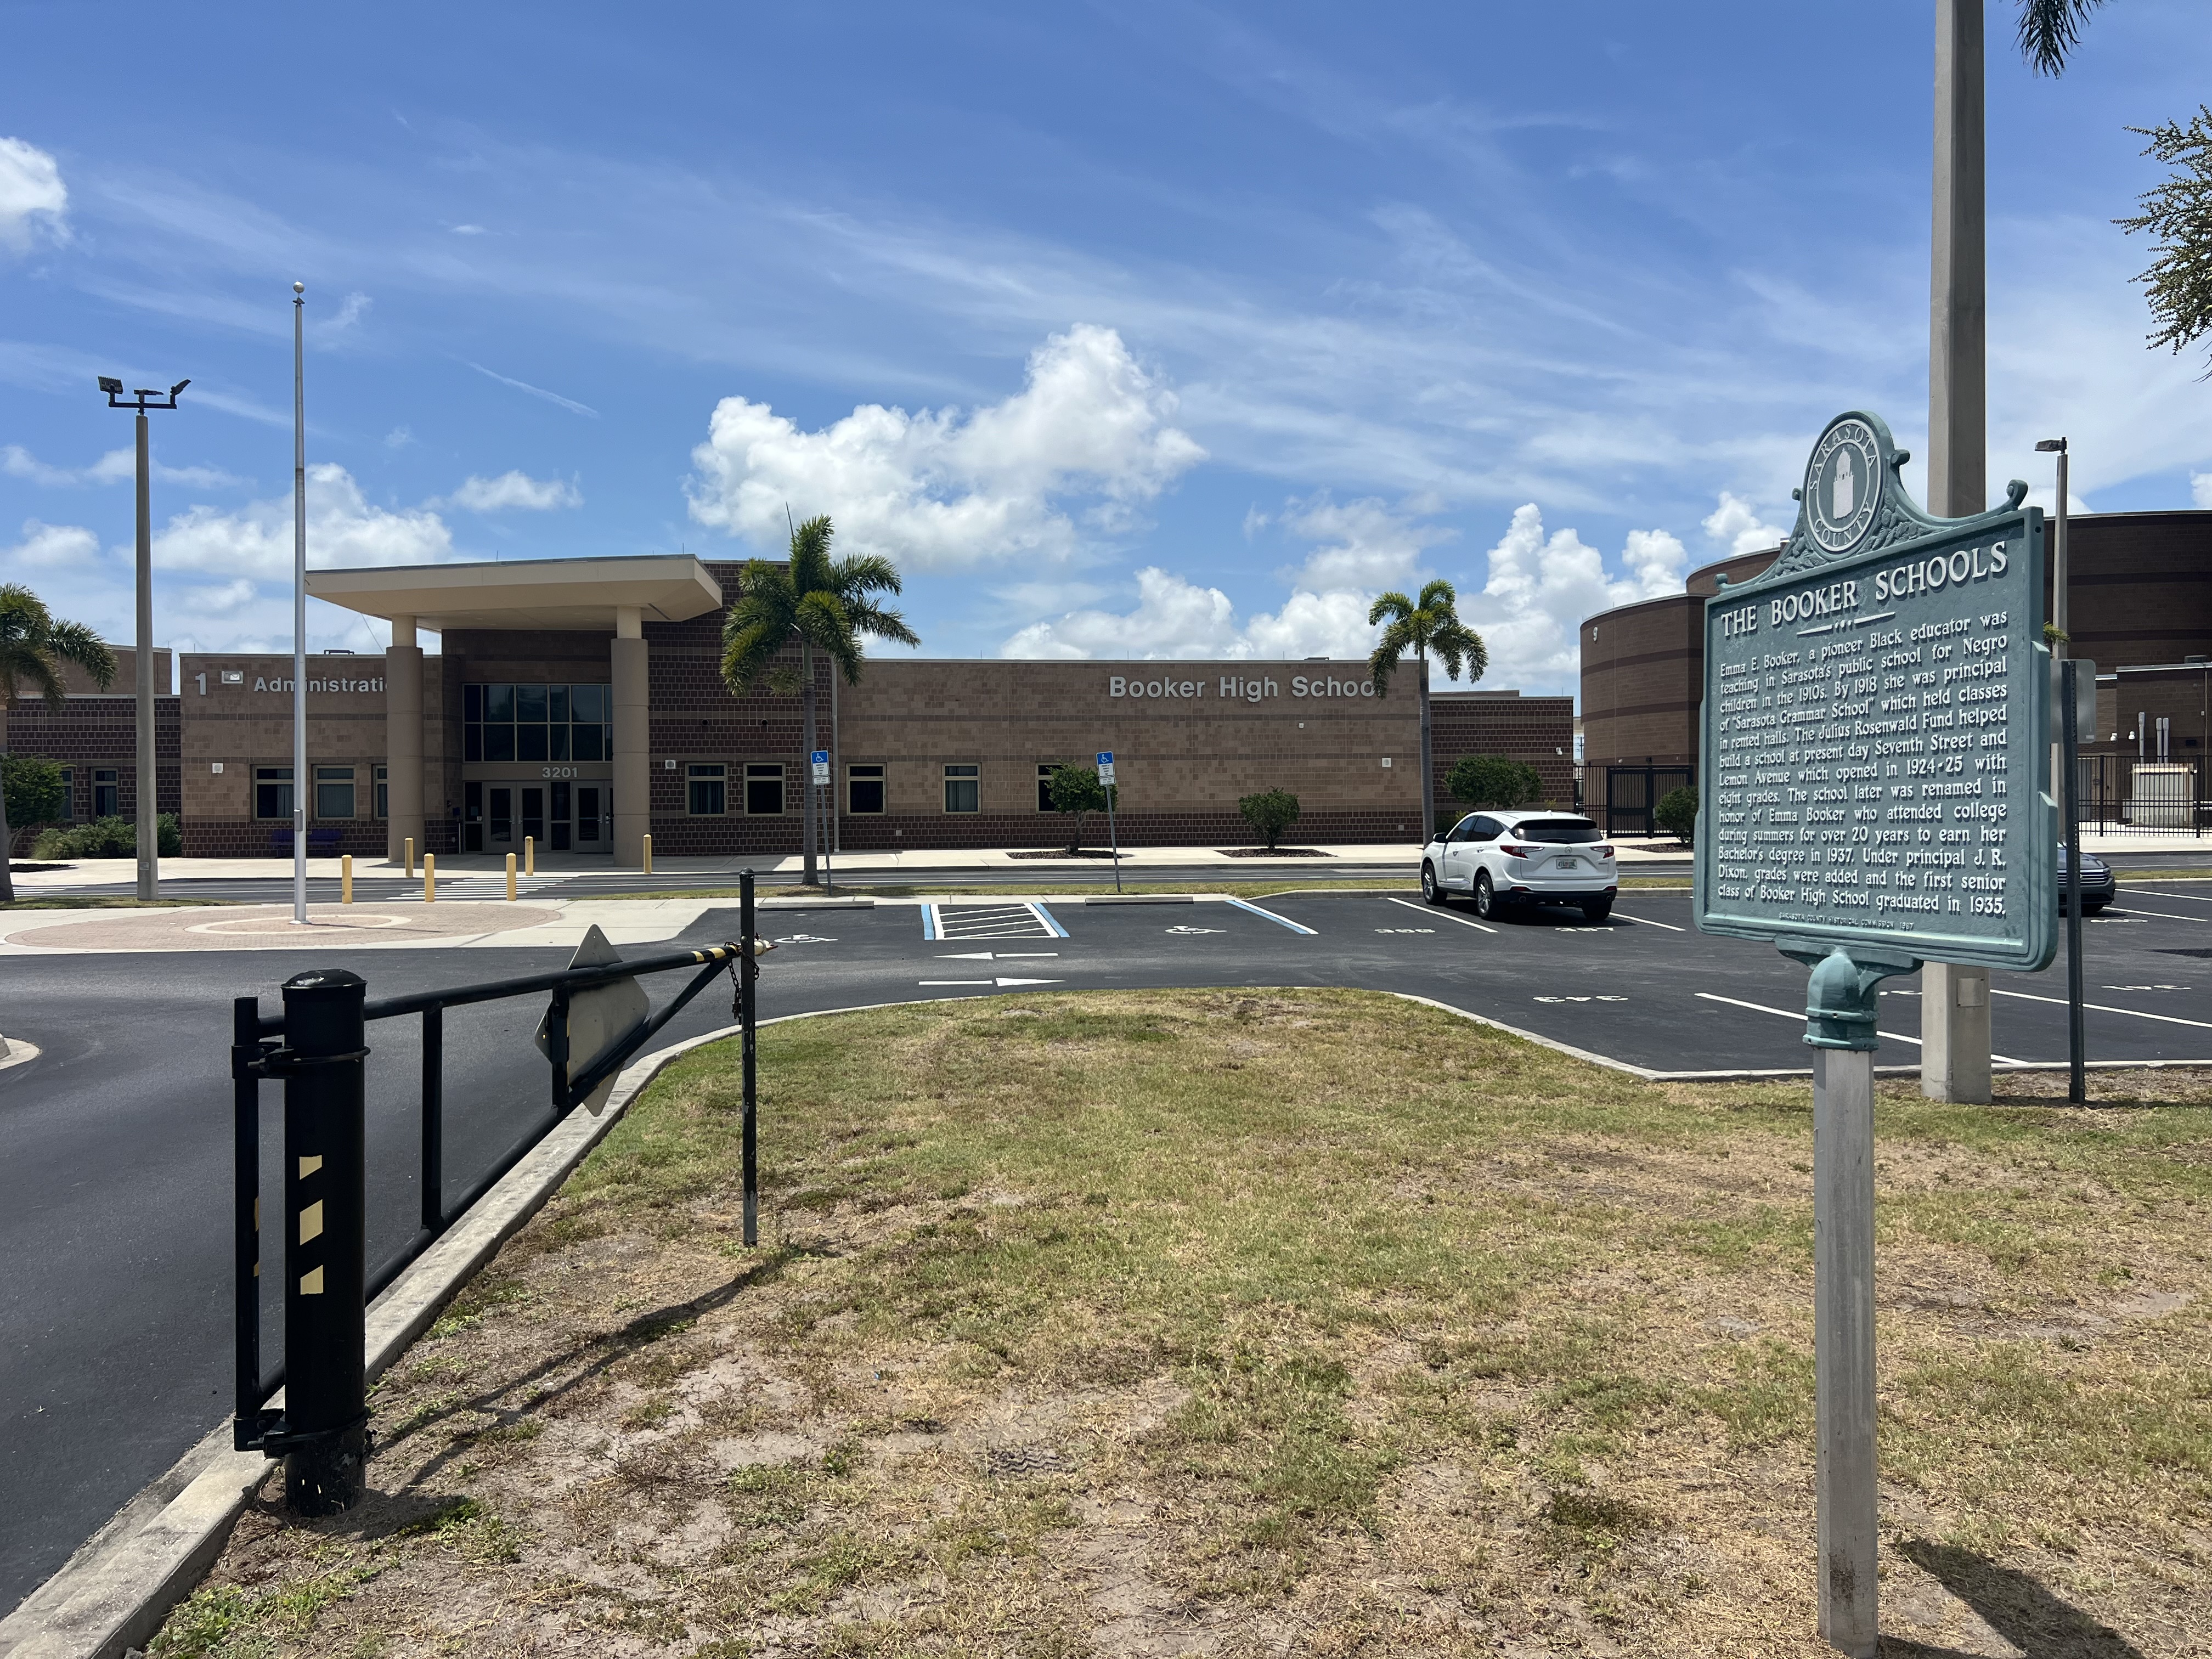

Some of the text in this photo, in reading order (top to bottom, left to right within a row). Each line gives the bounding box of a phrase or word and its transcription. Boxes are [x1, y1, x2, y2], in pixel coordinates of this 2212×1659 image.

[1810, 424, 1877, 490] SARASOTA
[1814, 500, 1871, 546] COUNTY
[1720, 541, 2007, 636] THE BOOKER SCHOOLS
[1593, 627, 1598, 641] 9
[1720, 663, 1746, 676] Emma
[1751, 657, 1759, 671] E.
[1809, 649, 1815, 659] a
[1821, 639, 1864, 661] pioneer
[1870, 629, 1903, 648] Black
[1910, 618, 1971, 640] educator
[1980, 611, 2007, 627] was
[1720, 635, 2007, 694] teaching in Sarasota's public school for Negro
[195, 673, 206, 695] 1
[253, 677, 387, 692] Administrati
[1109, 676, 1377, 702] Booker High Schoo
[1720, 656, 2007, 712] children in the 1910s. By 1918 she was principal
[1720, 718, 1729, 731] of
[1780, 708, 1826, 724] Grammar
[1881, 693, 1916, 711] which
[1923, 688, 1951, 706] held
[1958, 684, 2007, 702] classes
[1720, 704, 2007, 749] in rented halls. The Julius Rosenwald Fund helped
[1719, 728, 2007, 768] build a school at present day Seventh Street and
[542, 767, 577, 778] 3201
[1719, 753, 2007, 786] Lemon Avenue which opened in 1924-25 with
[1719, 776, 2006, 807] eight grades. The school later was renamed in
[1719, 802, 2007, 822] honor of Emma Booker who attended college
[1718, 825, 2006, 845] during summers for over 20 years to earn her
[1718, 846, 2006, 868] Bachelor's degree in 1937. Under principal J. R.
[1754, 867, 1787, 883] grades
[1793, 870, 1819, 882] were
[1825, 869, 1859, 884] added
[1865, 870, 1887, 885] and
[1895, 871, 1915, 886] the
[1923, 871, 1953, 888] first
[1961, 873, 2006, 890] senior
[1718, 884, 2006, 915] class of Booker High School graduated in 1935.
